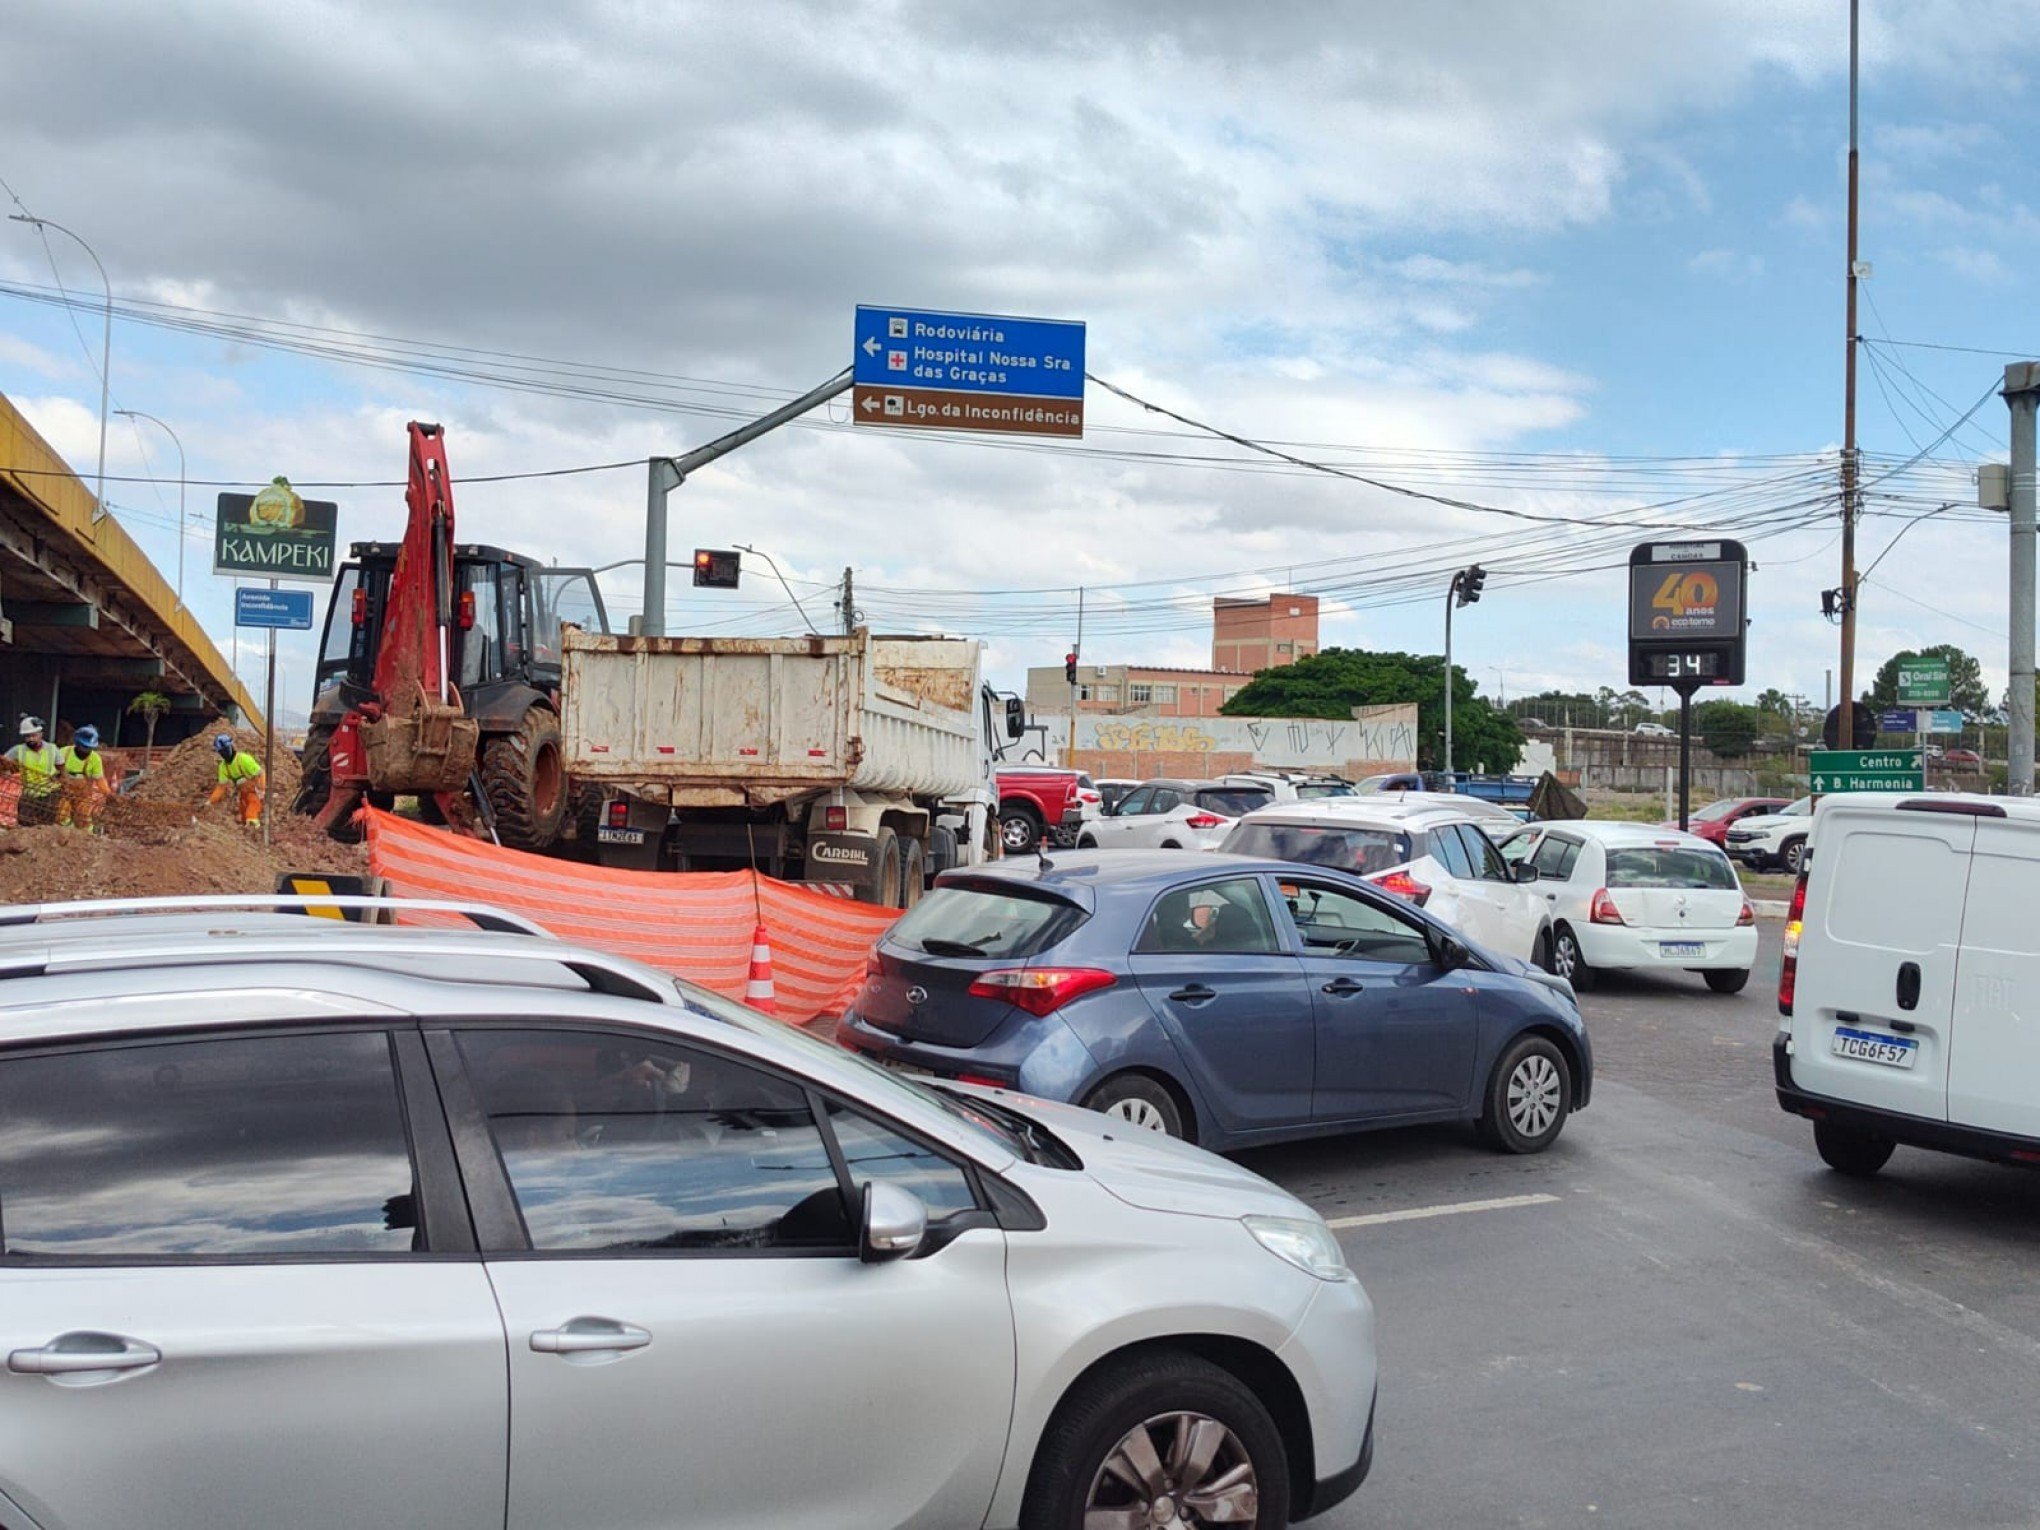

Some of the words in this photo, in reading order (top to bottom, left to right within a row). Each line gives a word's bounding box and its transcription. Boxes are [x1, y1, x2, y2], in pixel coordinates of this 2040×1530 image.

[914, 322, 1004, 343] Rodoviária
[913, 347, 983, 364] Hospital
[989, 353, 1036, 367] Nossa
[1043, 356, 1071, 370] Sra
[914, 366, 943, 379] das
[950, 367, 1007, 385] Graças
[941, 403, 961, 417] da
[965, 404, 1080, 425] Inconfidência
[222, 538, 329, 568] KAMPEKI
[1652, 571, 1719, 616] 40
[1685, 606, 1715, 616] anos
[1668, 655, 1701, 677] 34
[1859, 756, 1902, 767] Centro
[1850, 777, 1913, 790] Harmonia
[1841, 1037, 1907, 1062] TCG6F57
